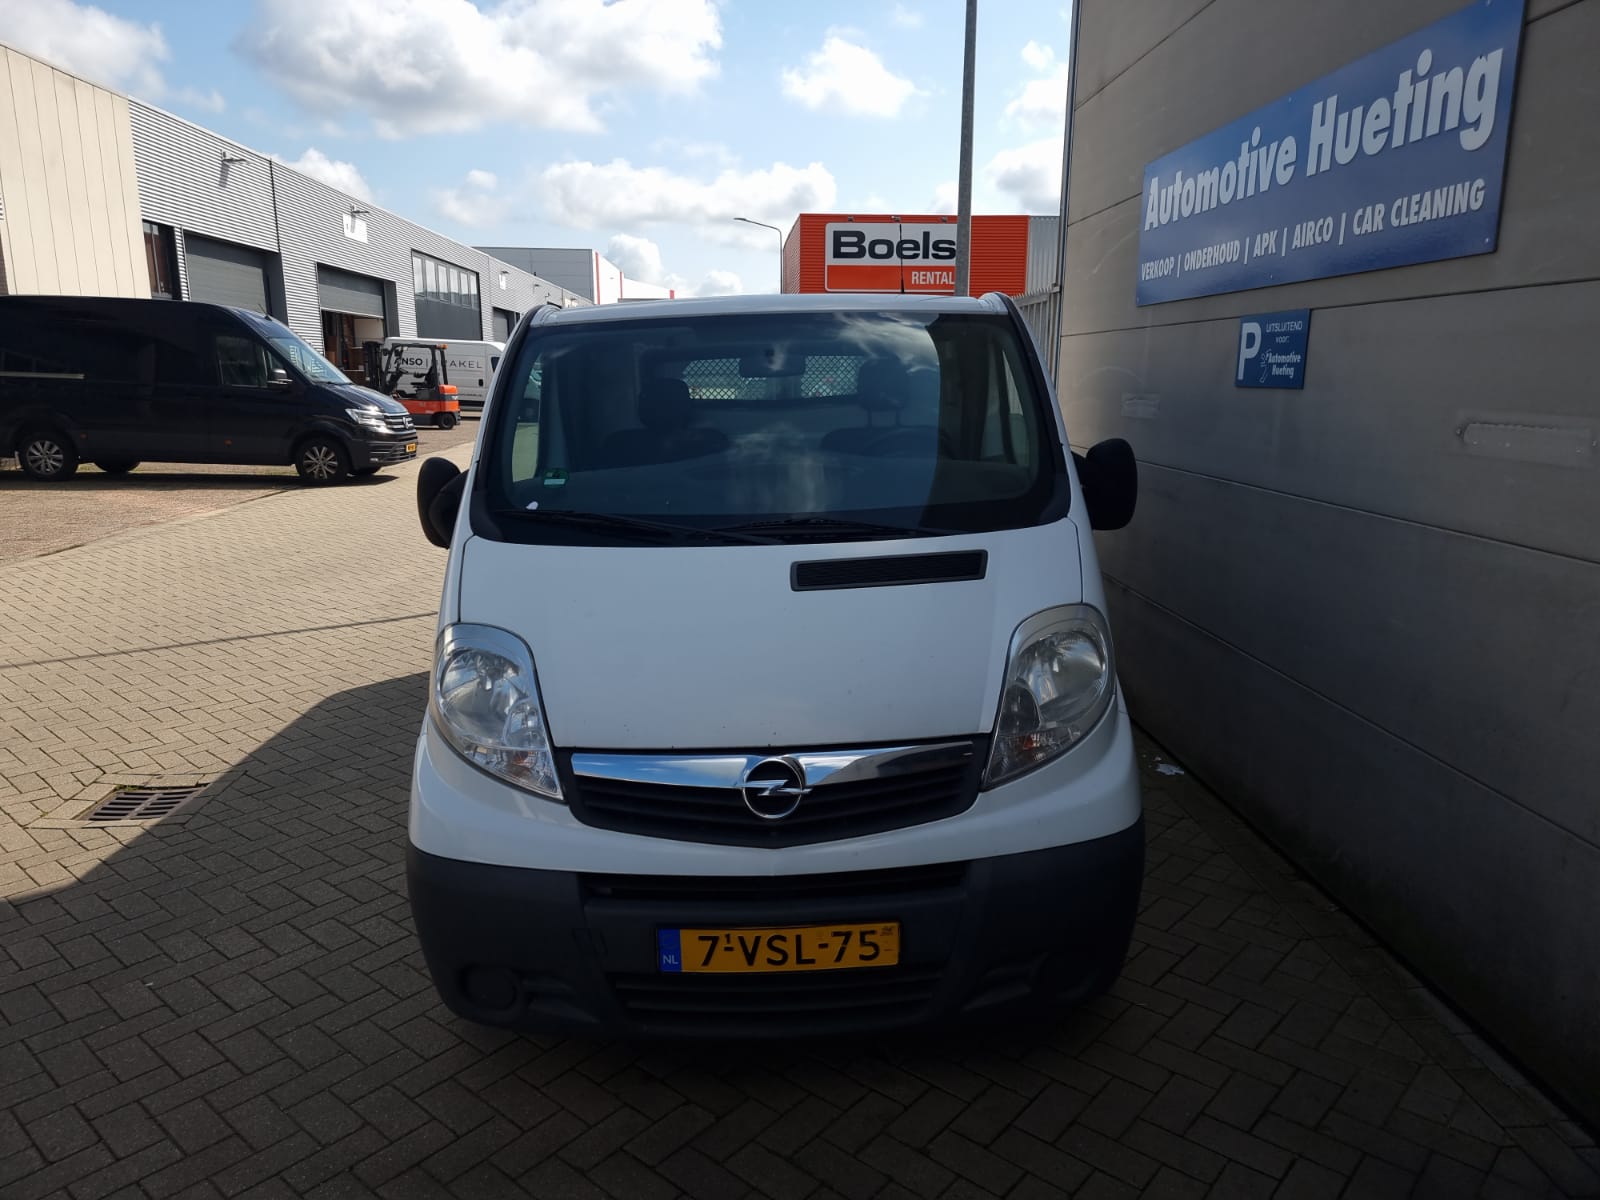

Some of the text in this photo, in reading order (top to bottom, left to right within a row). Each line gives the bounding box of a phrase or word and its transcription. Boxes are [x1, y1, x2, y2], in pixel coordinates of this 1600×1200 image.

[1145, 49, 1504, 231] Automotive Hueting
[1141, 178, 1485, 280] VERKOOP ONDERHOUD APK AIRCO CAR CLEANING
[833, 230, 956, 260] Boels
[911, 271, 955, 285] RENTAL
[1266, 321, 1302, 333] UITSLUITEND
[1238, 322, 1261, 380] P
[1267, 352, 1301, 363] Automotive
[1272, 364, 1294, 378] Hueting
[663, 955, 679, 965] NL
[698, 930, 881, 967] 7-VSL-75
